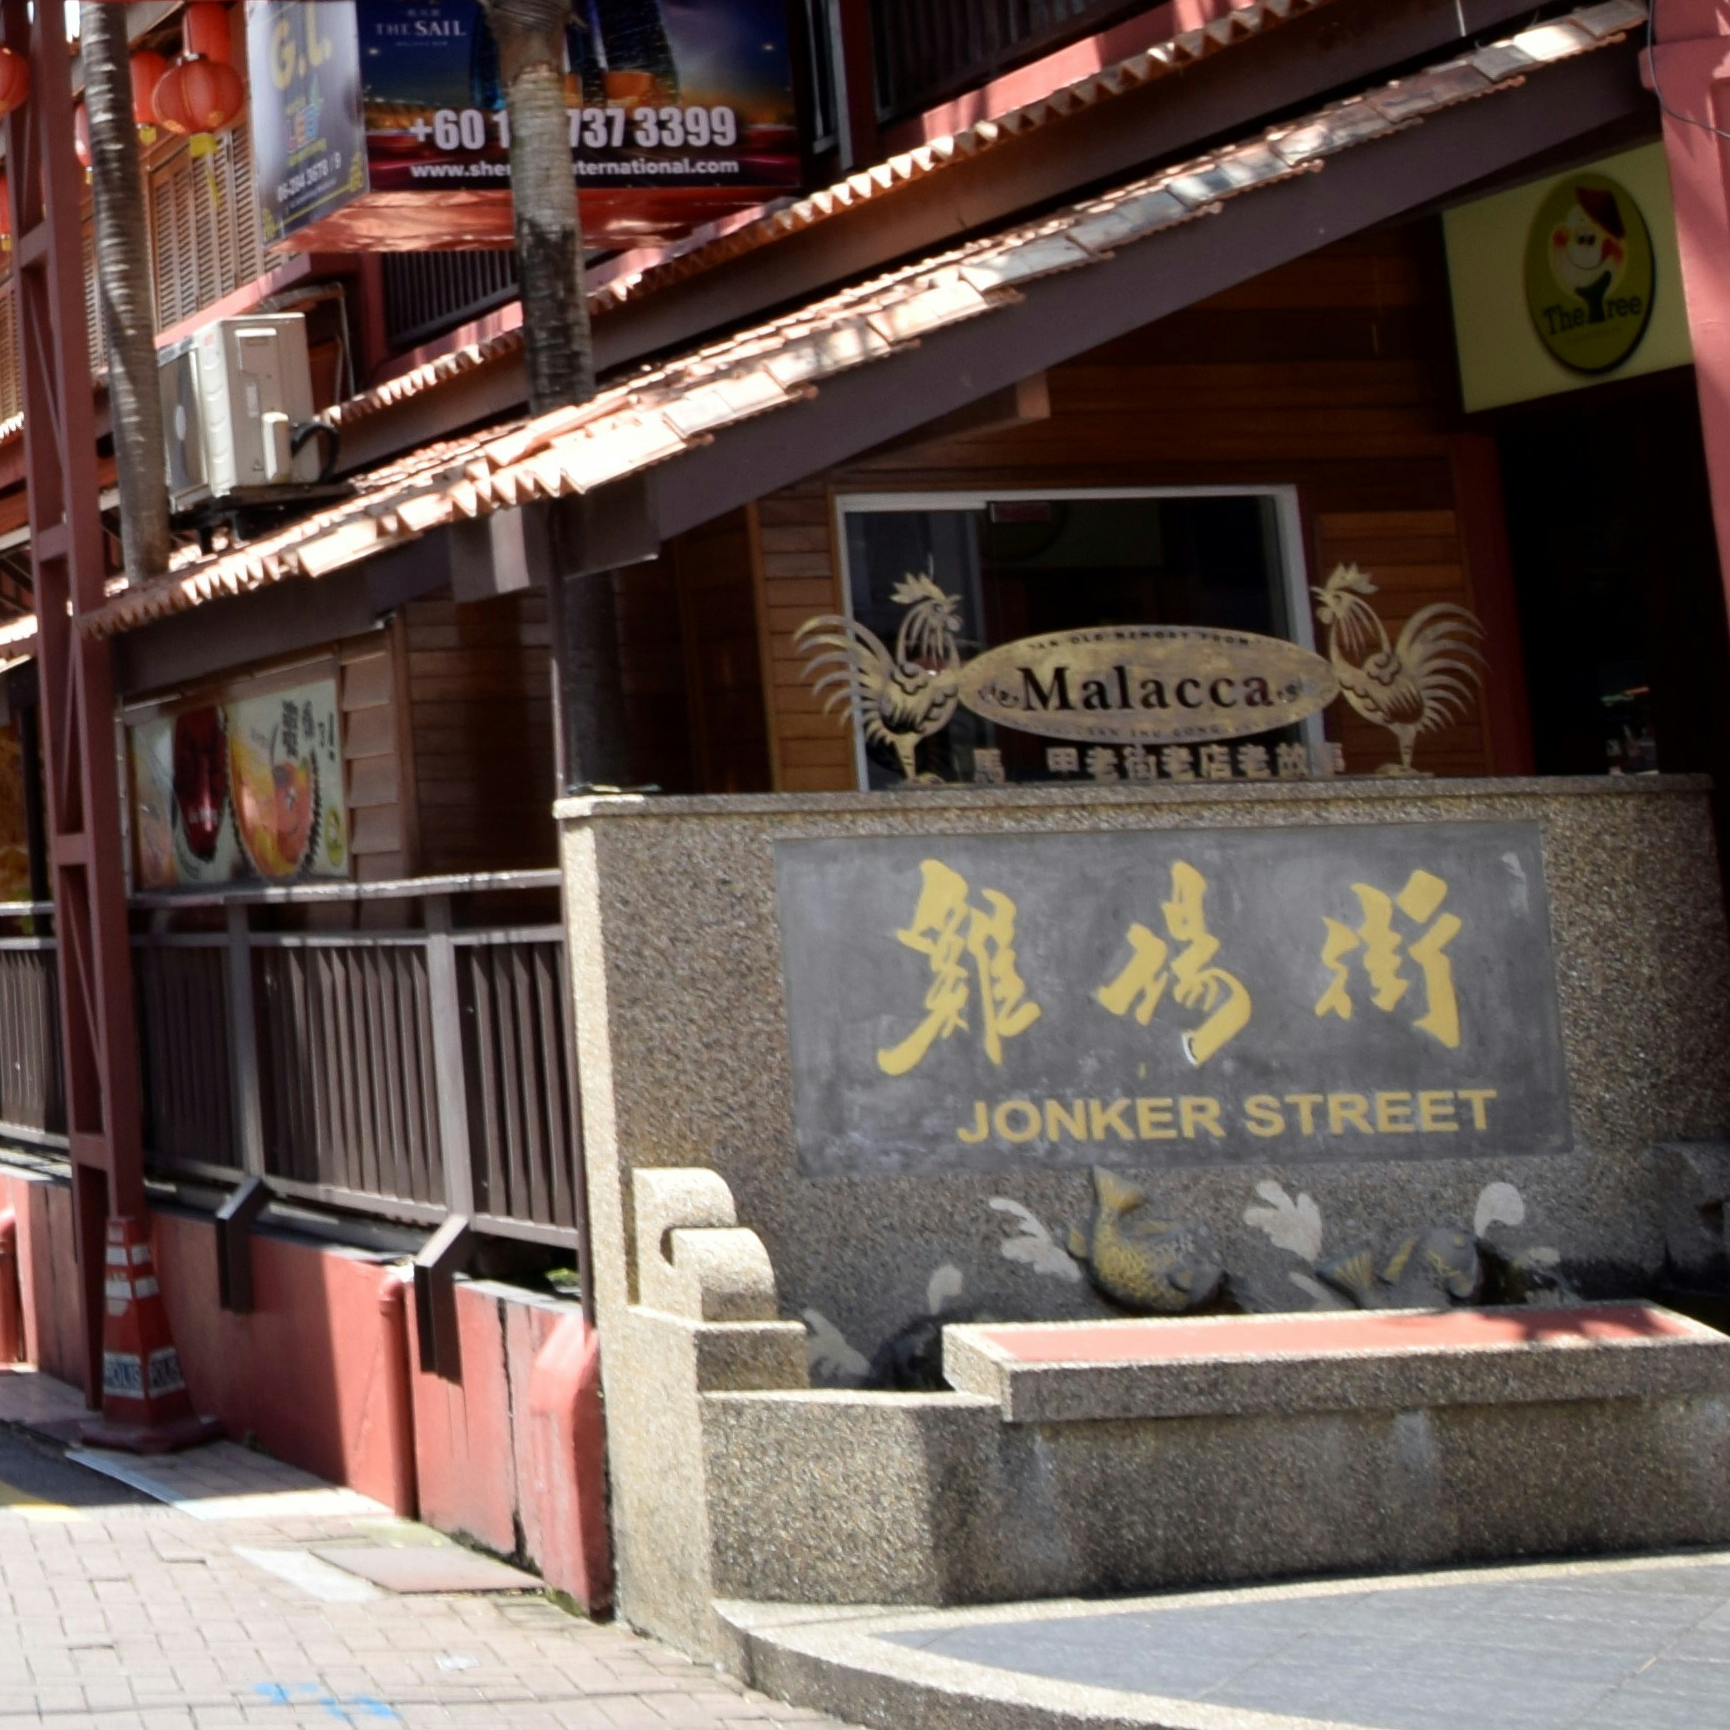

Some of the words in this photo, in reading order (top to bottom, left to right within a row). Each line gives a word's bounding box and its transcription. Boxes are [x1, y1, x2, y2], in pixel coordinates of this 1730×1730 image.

[374, 22, 410, 36] THE
[413, 20, 467, 38] SAIL
[409, 108, 486, 151] +60
[492, 112, 513, 149] 1
[633, 106, 738, 148] 3399
[1016, 665, 1275, 714] Malacca
[957, 1092, 1226, 1145] JONKER
[1245, 1086, 1498, 1139] STREET
